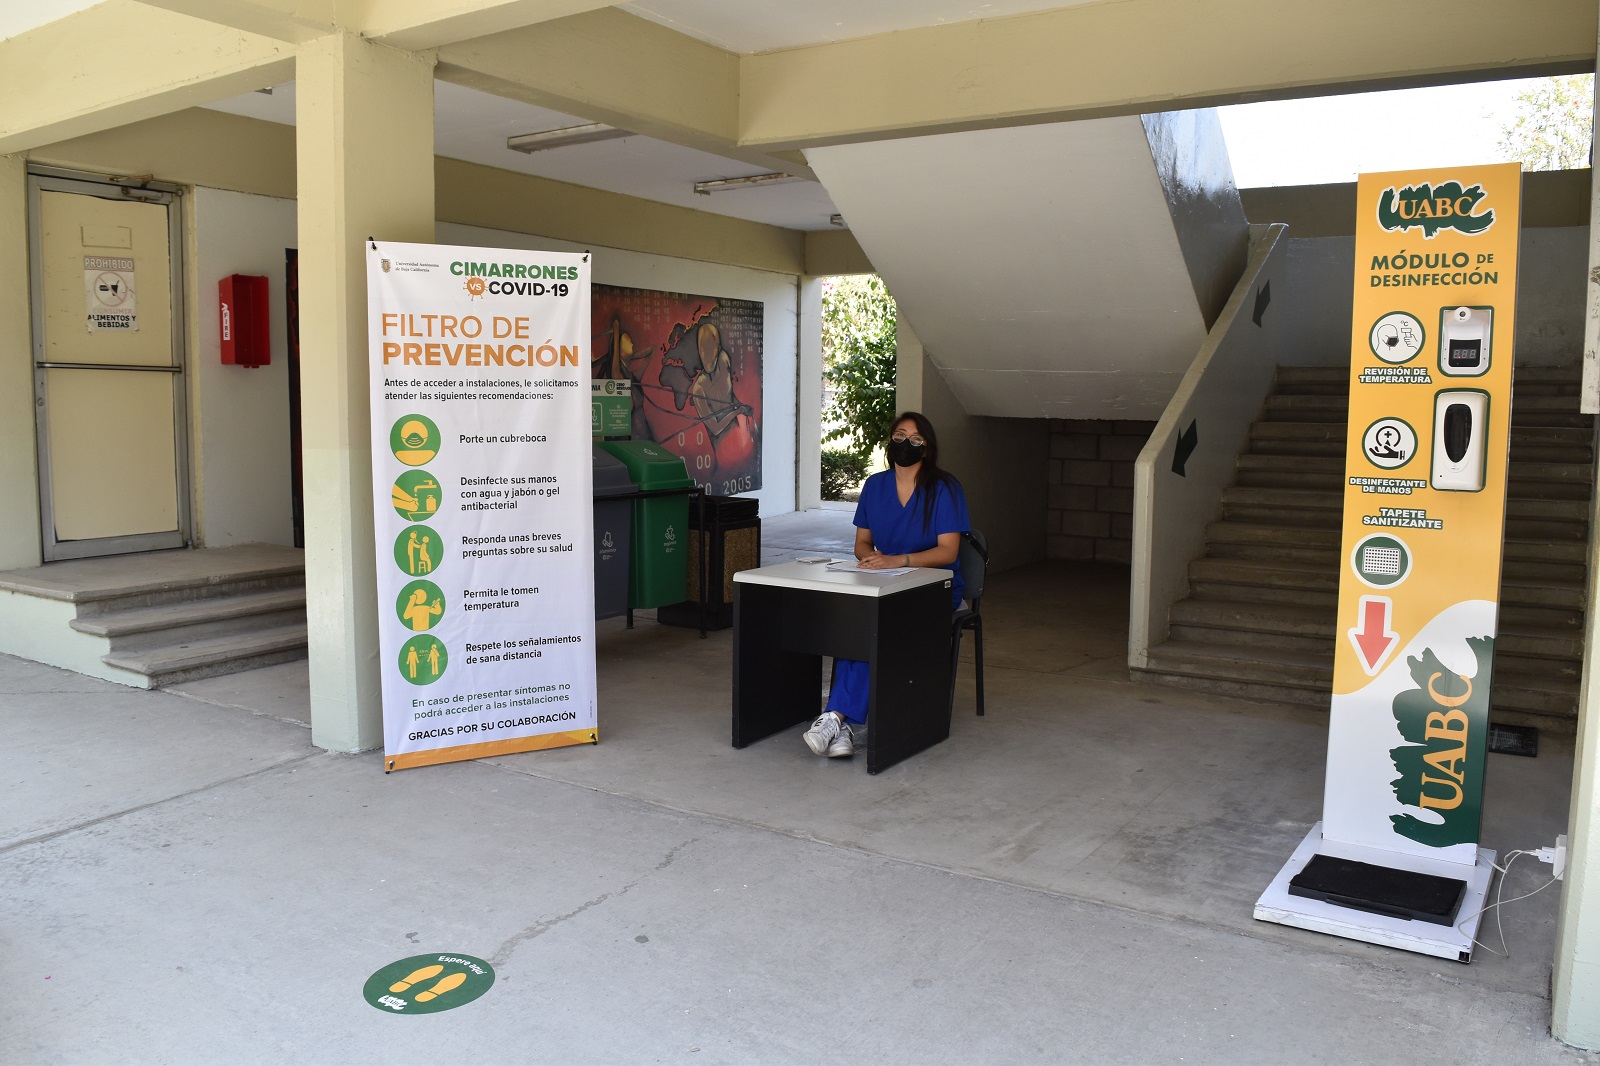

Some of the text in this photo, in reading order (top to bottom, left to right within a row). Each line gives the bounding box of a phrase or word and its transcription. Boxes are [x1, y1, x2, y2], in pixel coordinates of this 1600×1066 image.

[1398, 196, 1472, 220] UABC
[84, 258, 133, 269] PROHIBIDO
[1370, 249, 1494, 270] MÓDULO DE
[450, 261, 578, 280] CIMARRONES
[1370, 266, 1498, 287] DESINFECCIÓN
[488, 281, 569, 297] COVID-19
[382, 313, 530, 339] FILTRO DE
[383, 339, 579, 367] PREVENCIÓN
[1364, 367, 1408, 375] REVISIÓN
[384, 378, 408, 387] Antes
[410, 378, 421, 387] de
[424, 379, 456, 387] acceder
[466, 379, 522, 389] instalaciones,
[524, 379, 531, 387] le
[534, 379, 578, 388] solicitamos
[385, 392, 553, 402] atender las siguientes recomendaciones:
[459, 434, 484, 443] Porte
[500, 434, 547, 443] cubreboca
[461, 476, 508, 486] Desinfecte
[723, 476, 751, 495] 2005
[1350, 478, 1426, 487] DESINFECTANTE
[480, 490, 502, 499] agua
[504, 490, 510, 498] y
[511, 487, 536, 498] jabón
[546, 487, 560, 496] gel
[461, 501, 518, 511] antibacterial
[1380, 508, 1425, 518] TAPETE
[1363, 516, 1442, 529] SANITIZANTE
[462, 535, 506, 546] Responda
[532, 533, 562, 542] breves
[462, 548, 508, 559] preguntas
[510, 546, 535, 555] sobre
[550, 543, 572, 553] salud
[464, 586, 539, 599] Permita le tomen
[464, 600, 519, 612] temperatura
[466, 635, 582, 653] Respete los señalamientos
[466, 650, 542, 665] de sana distancia
[412, 699, 425, 708] En
[427, 697, 450, 707] caso
[452, 694, 464, 703] de
[467, 688, 512, 702] presentar
[515, 683, 556, 695] síntomas
[414, 708, 443, 721] podrá
[445, 703, 483, 715] acceder
[494, 700, 507, 709] las
[509, 694, 570, 707] instalaciones
[408, 711, 576, 741] GRACIAS POR SU COLABORACIÓN
[1420, 672, 1472, 810] UABC
[438, 956, 470, 965] Espere
